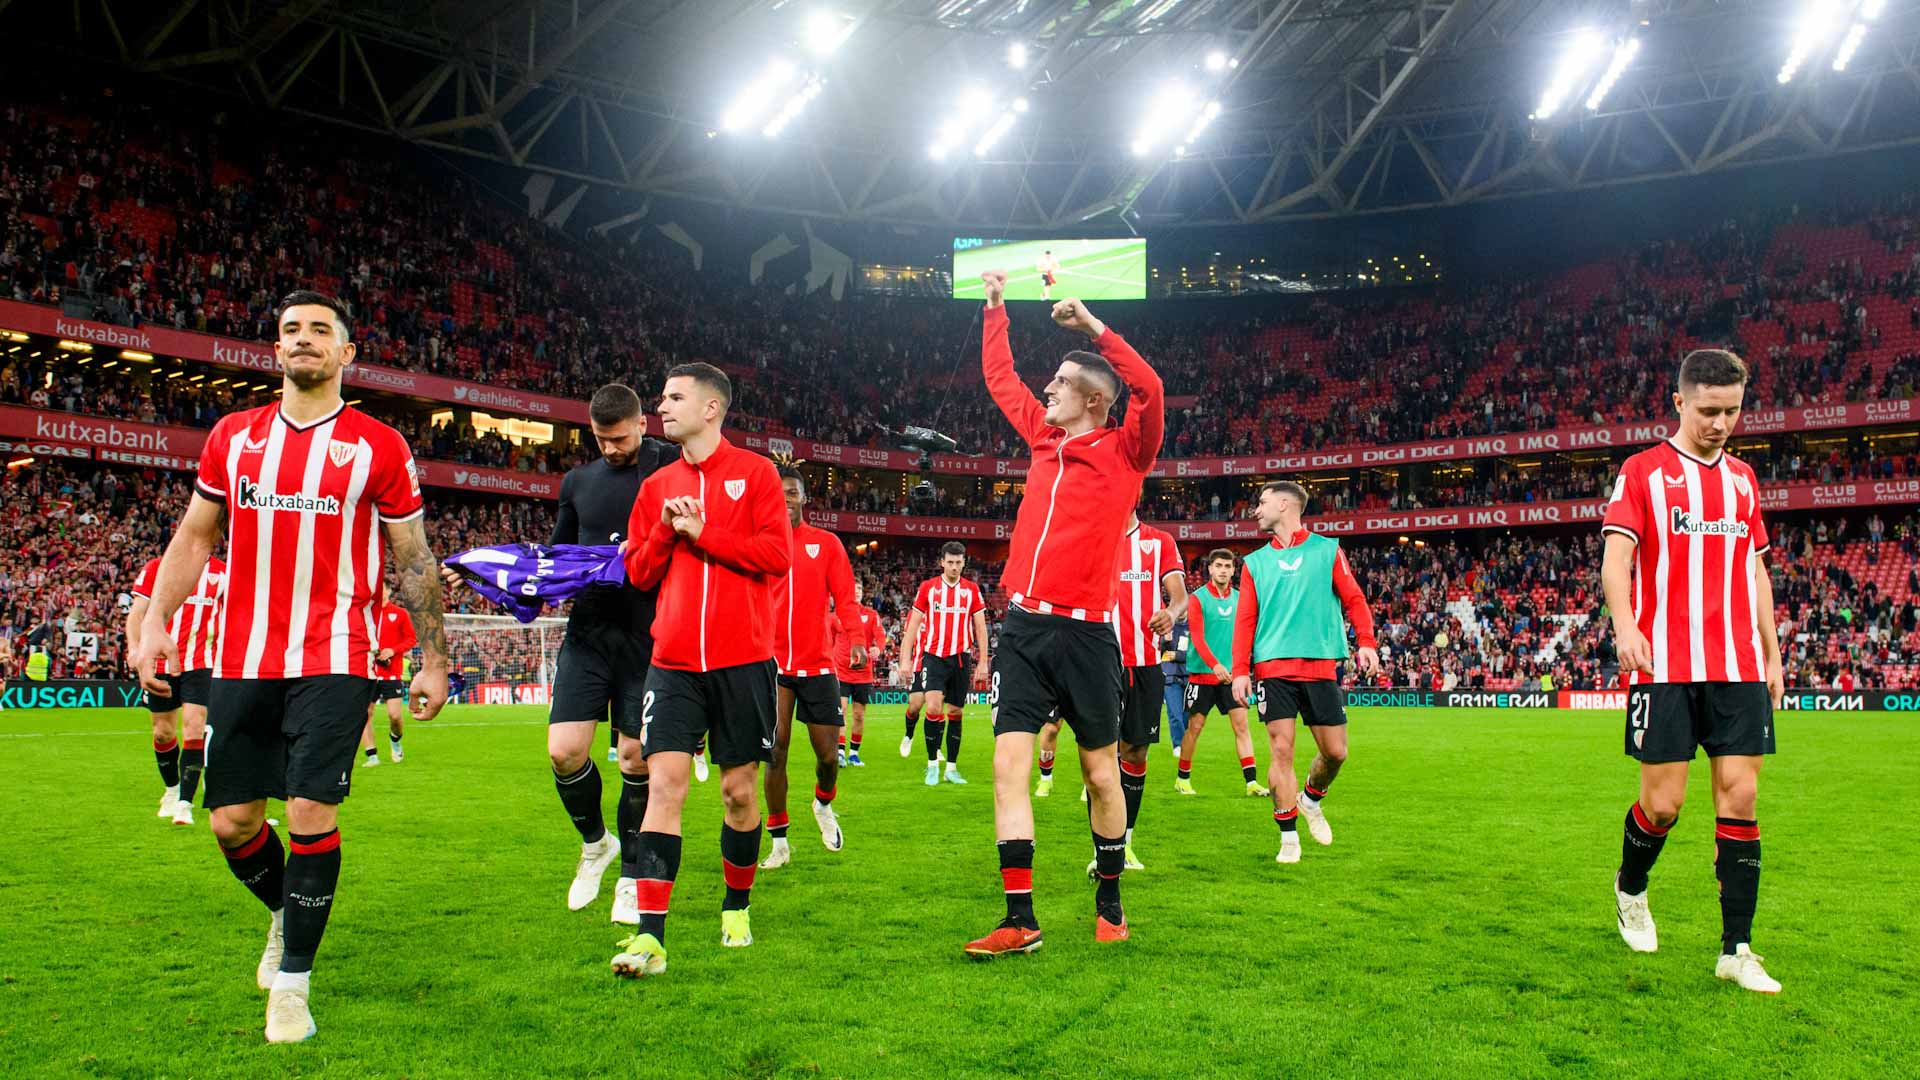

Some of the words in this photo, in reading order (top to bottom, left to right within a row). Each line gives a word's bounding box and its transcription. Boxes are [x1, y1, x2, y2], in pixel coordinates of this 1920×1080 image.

[56, 319, 150, 348] kutxabank
[213, 341, 284, 371] kutxa
[468, 389, 550, 413] @athletic_eus
[1865, 399, 1910, 414] CLUB
[1743, 411, 1785, 425] CLUB
[1803, 405, 1846, 419] CLUB
[1866, 412, 1910, 422] ATHLETIC
[1745, 422, 1785, 432] ATHLETIC
[1804, 418, 1846, 427] ATHLETIC
[36, 416, 168, 451] kutxabank
[1468, 440, 1506, 454] IMQ
[1519, 434, 1560, 450] IMQ
[1570, 429, 1613, 446] IMQ
[1625, 425, 1669, 442] IMQ
[812, 444, 841, 455] CLUB
[859, 449, 888, 460] CLUB
[101, 450, 178, 467] HERRI
[1266, 458, 1306, 469] DIGI
[1312, 454, 1352, 466] DIGI
[1363, 449, 1404, 461] DIGI
[1411, 445, 1454, 458] DIGI
[933, 461, 978, 470] STORE
[1234, 466, 1255, 474] travel
[468, 473, 551, 494] @athletic_eus
[1874, 480, 1920, 494] CLUB
[240, 478, 337, 513] Kutxabank
[1758, 489, 1789, 501] LUB
[1812, 484, 1856, 498] CLUB
[1876, 492, 1920, 501] ATHLETIC
[1760, 500, 1789, 508] HLETIC
[1814, 496, 1856, 505] ATHLETIC
[809, 512, 838, 522] CLUB
[857, 515, 887, 526] CLUB
[1469, 509, 1508, 525] IMQ
[1520, 506, 1560, 522] IMQ
[920, 525, 976, 534] CASTORE
[1313, 521, 1354, 532] DIGI
[1366, 517, 1409, 529] DIGI
[1415, 514, 1458, 527] DIGI
[1121, 570, 1151, 581] abank
[875, 691, 909, 704] DISPO
[1187, 685, 1199, 701] 24
[1257, 681, 1265, 701] 5
[1348, 693, 1434, 707] DISPONIBLE
[1570, 694, 1627, 709] IRIBAR
[1777, 695, 1863, 710] MERAN
[1631, 691, 1650, 729] 21
